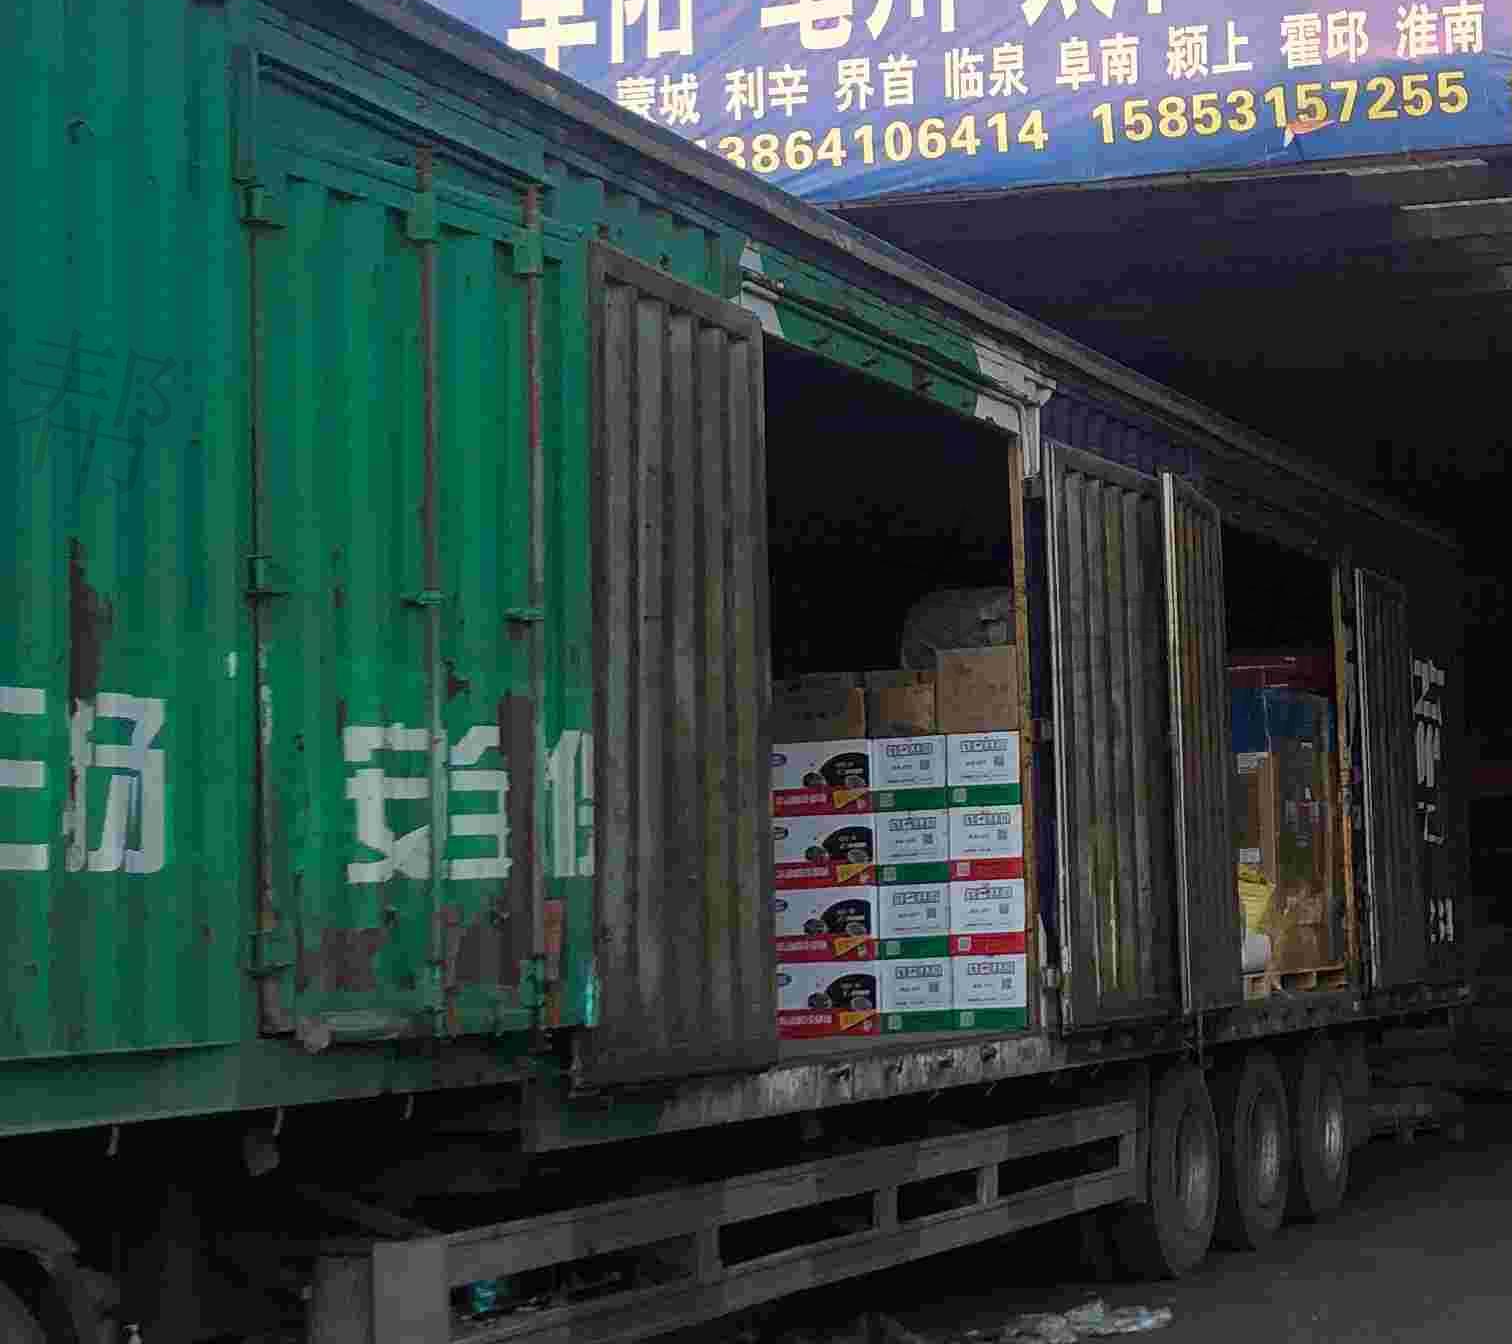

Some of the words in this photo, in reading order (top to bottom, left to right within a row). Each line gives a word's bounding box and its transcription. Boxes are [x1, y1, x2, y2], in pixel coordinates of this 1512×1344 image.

[725, 64, 808, 120] 利辛
[835, 51, 919, 113] 界首
[944, 42, 1028, 101] 临泉
[1055, 33, 1141, 91] 阜南
[1281, 10, 1368, 69] 霍邱
[1396, 0, 1484, 59] 淮南
[694, 109, 1049, 174] 3864106414
[1091, 69, 1469, 144] 15853157255
